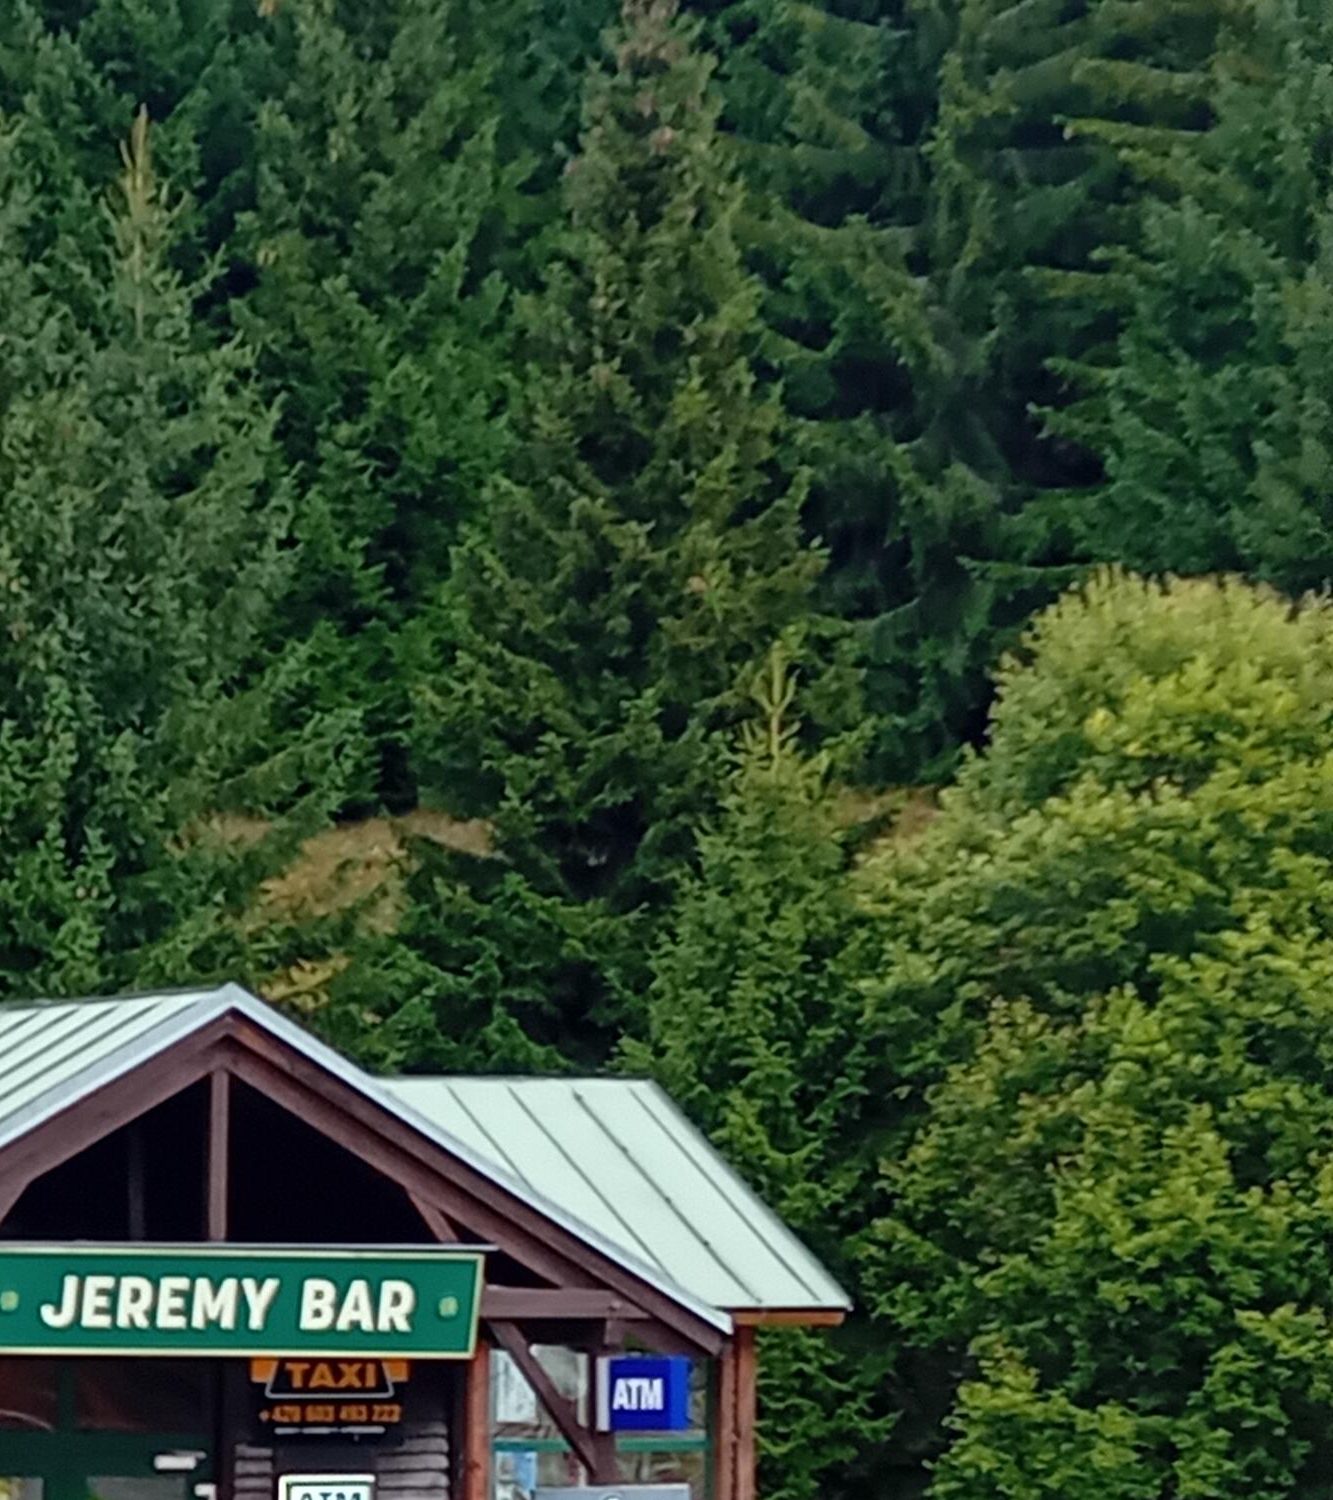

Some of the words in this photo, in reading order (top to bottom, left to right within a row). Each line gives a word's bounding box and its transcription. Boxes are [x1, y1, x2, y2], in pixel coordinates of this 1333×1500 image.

[40, 1275, 280, 1330] JEREMY
[299, 1279, 415, 1333] BAR
[285, 1362, 377, 1389] TAXI
[612, 1378, 664, 1410] ATM
